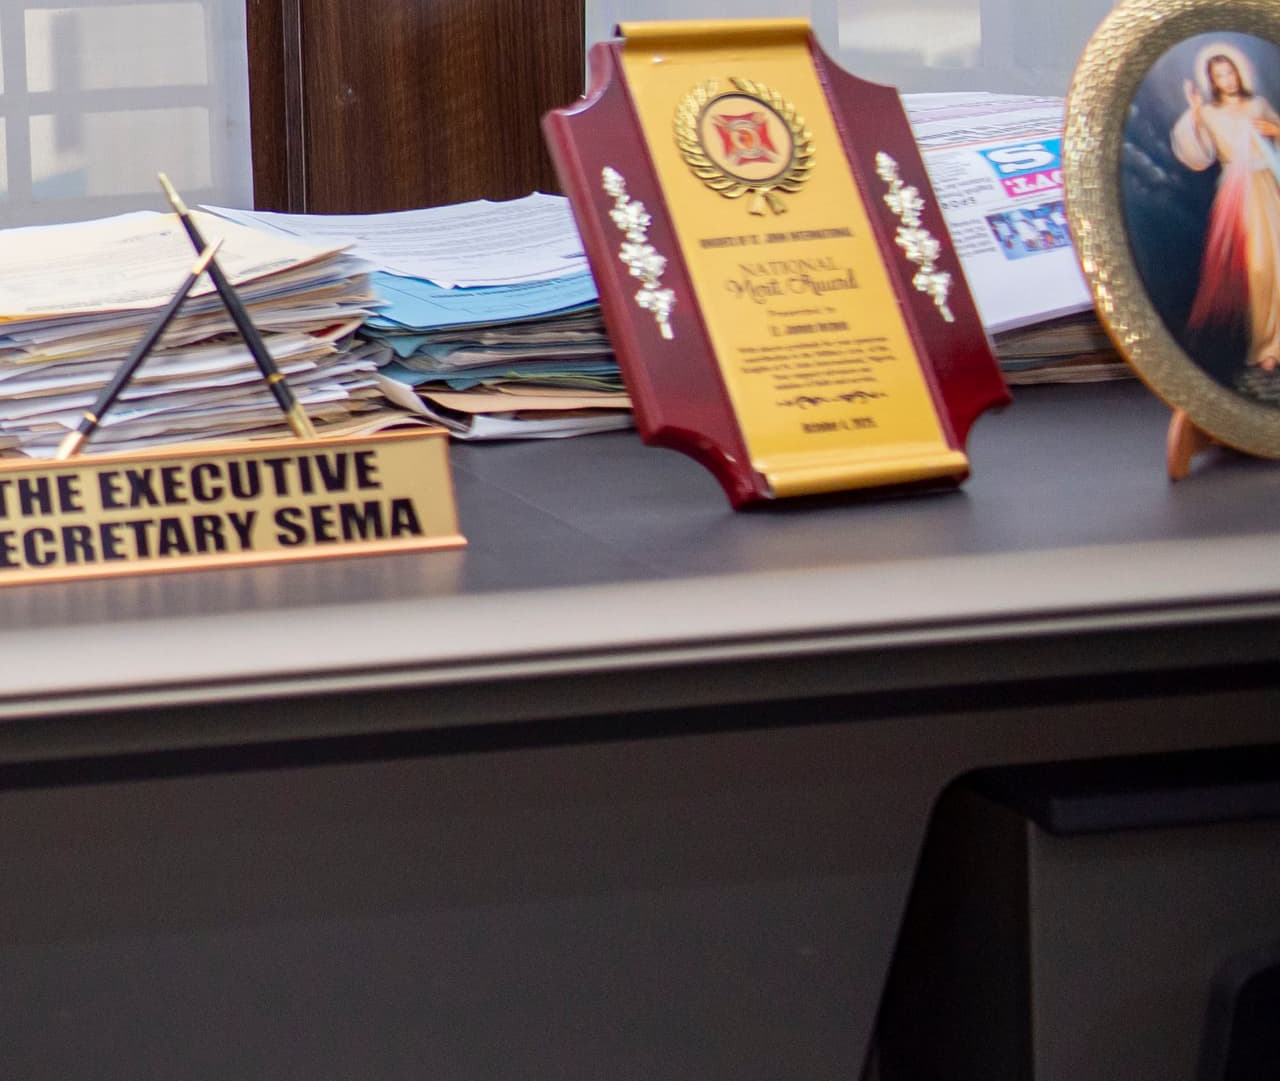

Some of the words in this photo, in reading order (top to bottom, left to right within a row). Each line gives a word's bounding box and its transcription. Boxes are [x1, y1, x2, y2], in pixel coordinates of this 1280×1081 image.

[738, 257, 841, 276] NATIONAL
[96, 449, 383, 511] EXECUTIVE
[274, 497, 423, 547] SEMA
